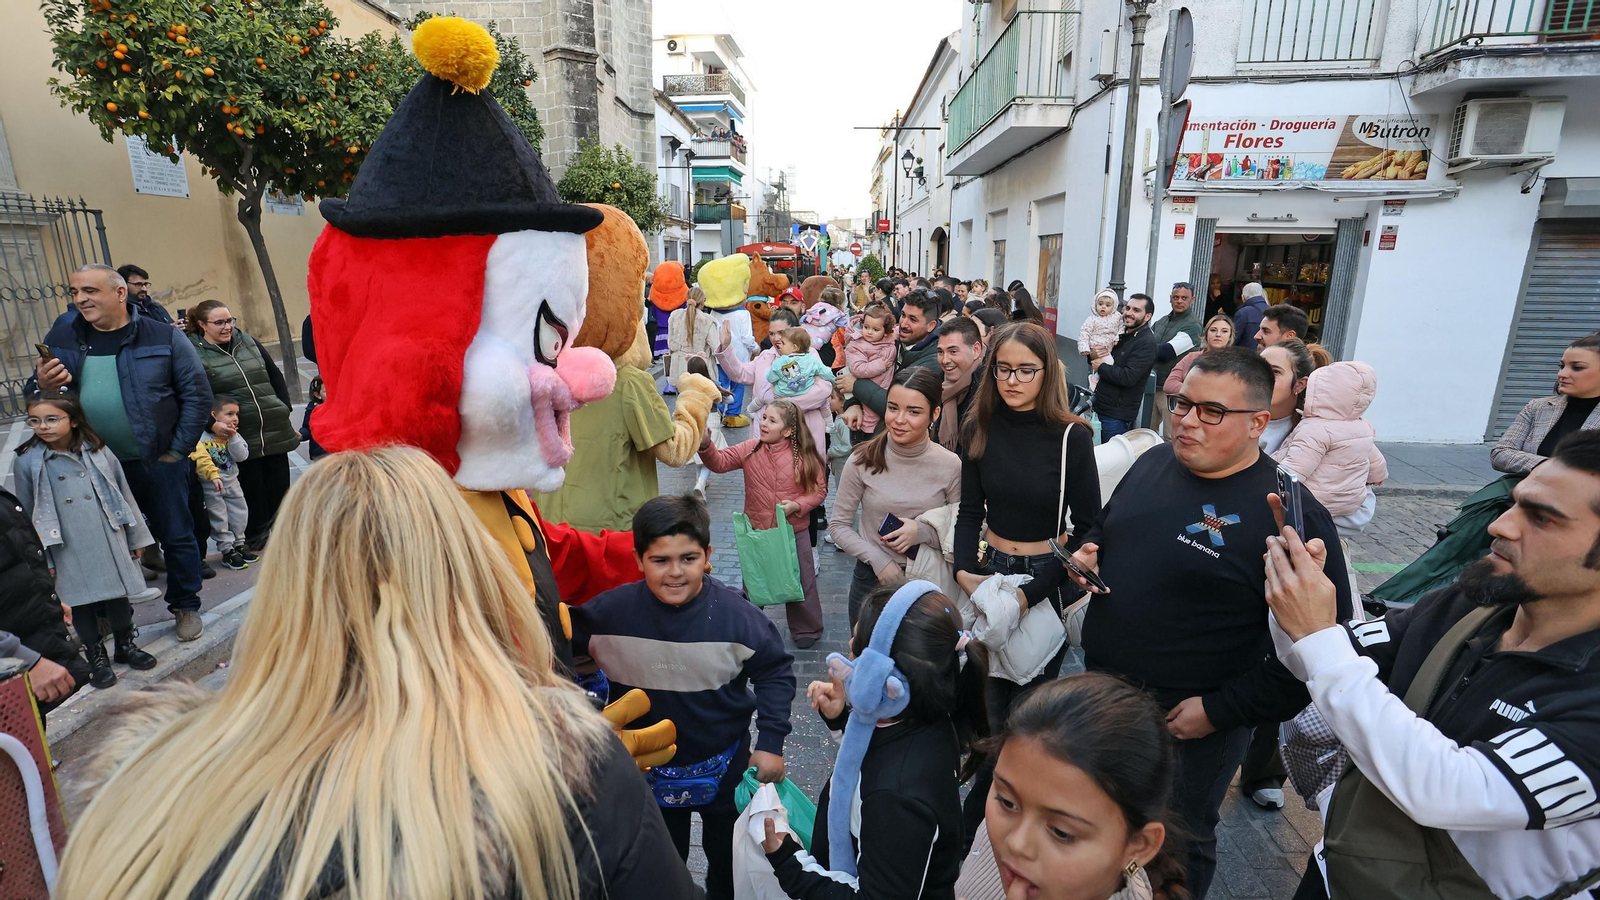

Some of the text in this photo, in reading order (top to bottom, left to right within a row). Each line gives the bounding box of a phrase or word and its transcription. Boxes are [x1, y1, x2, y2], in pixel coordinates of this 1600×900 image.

[1186, 119, 1256, 131] imentación
[1270, 119, 1336, 133] Droguería
[1224, 133, 1284, 148] Flores
[1177, 533, 1220, 558] blue banana
